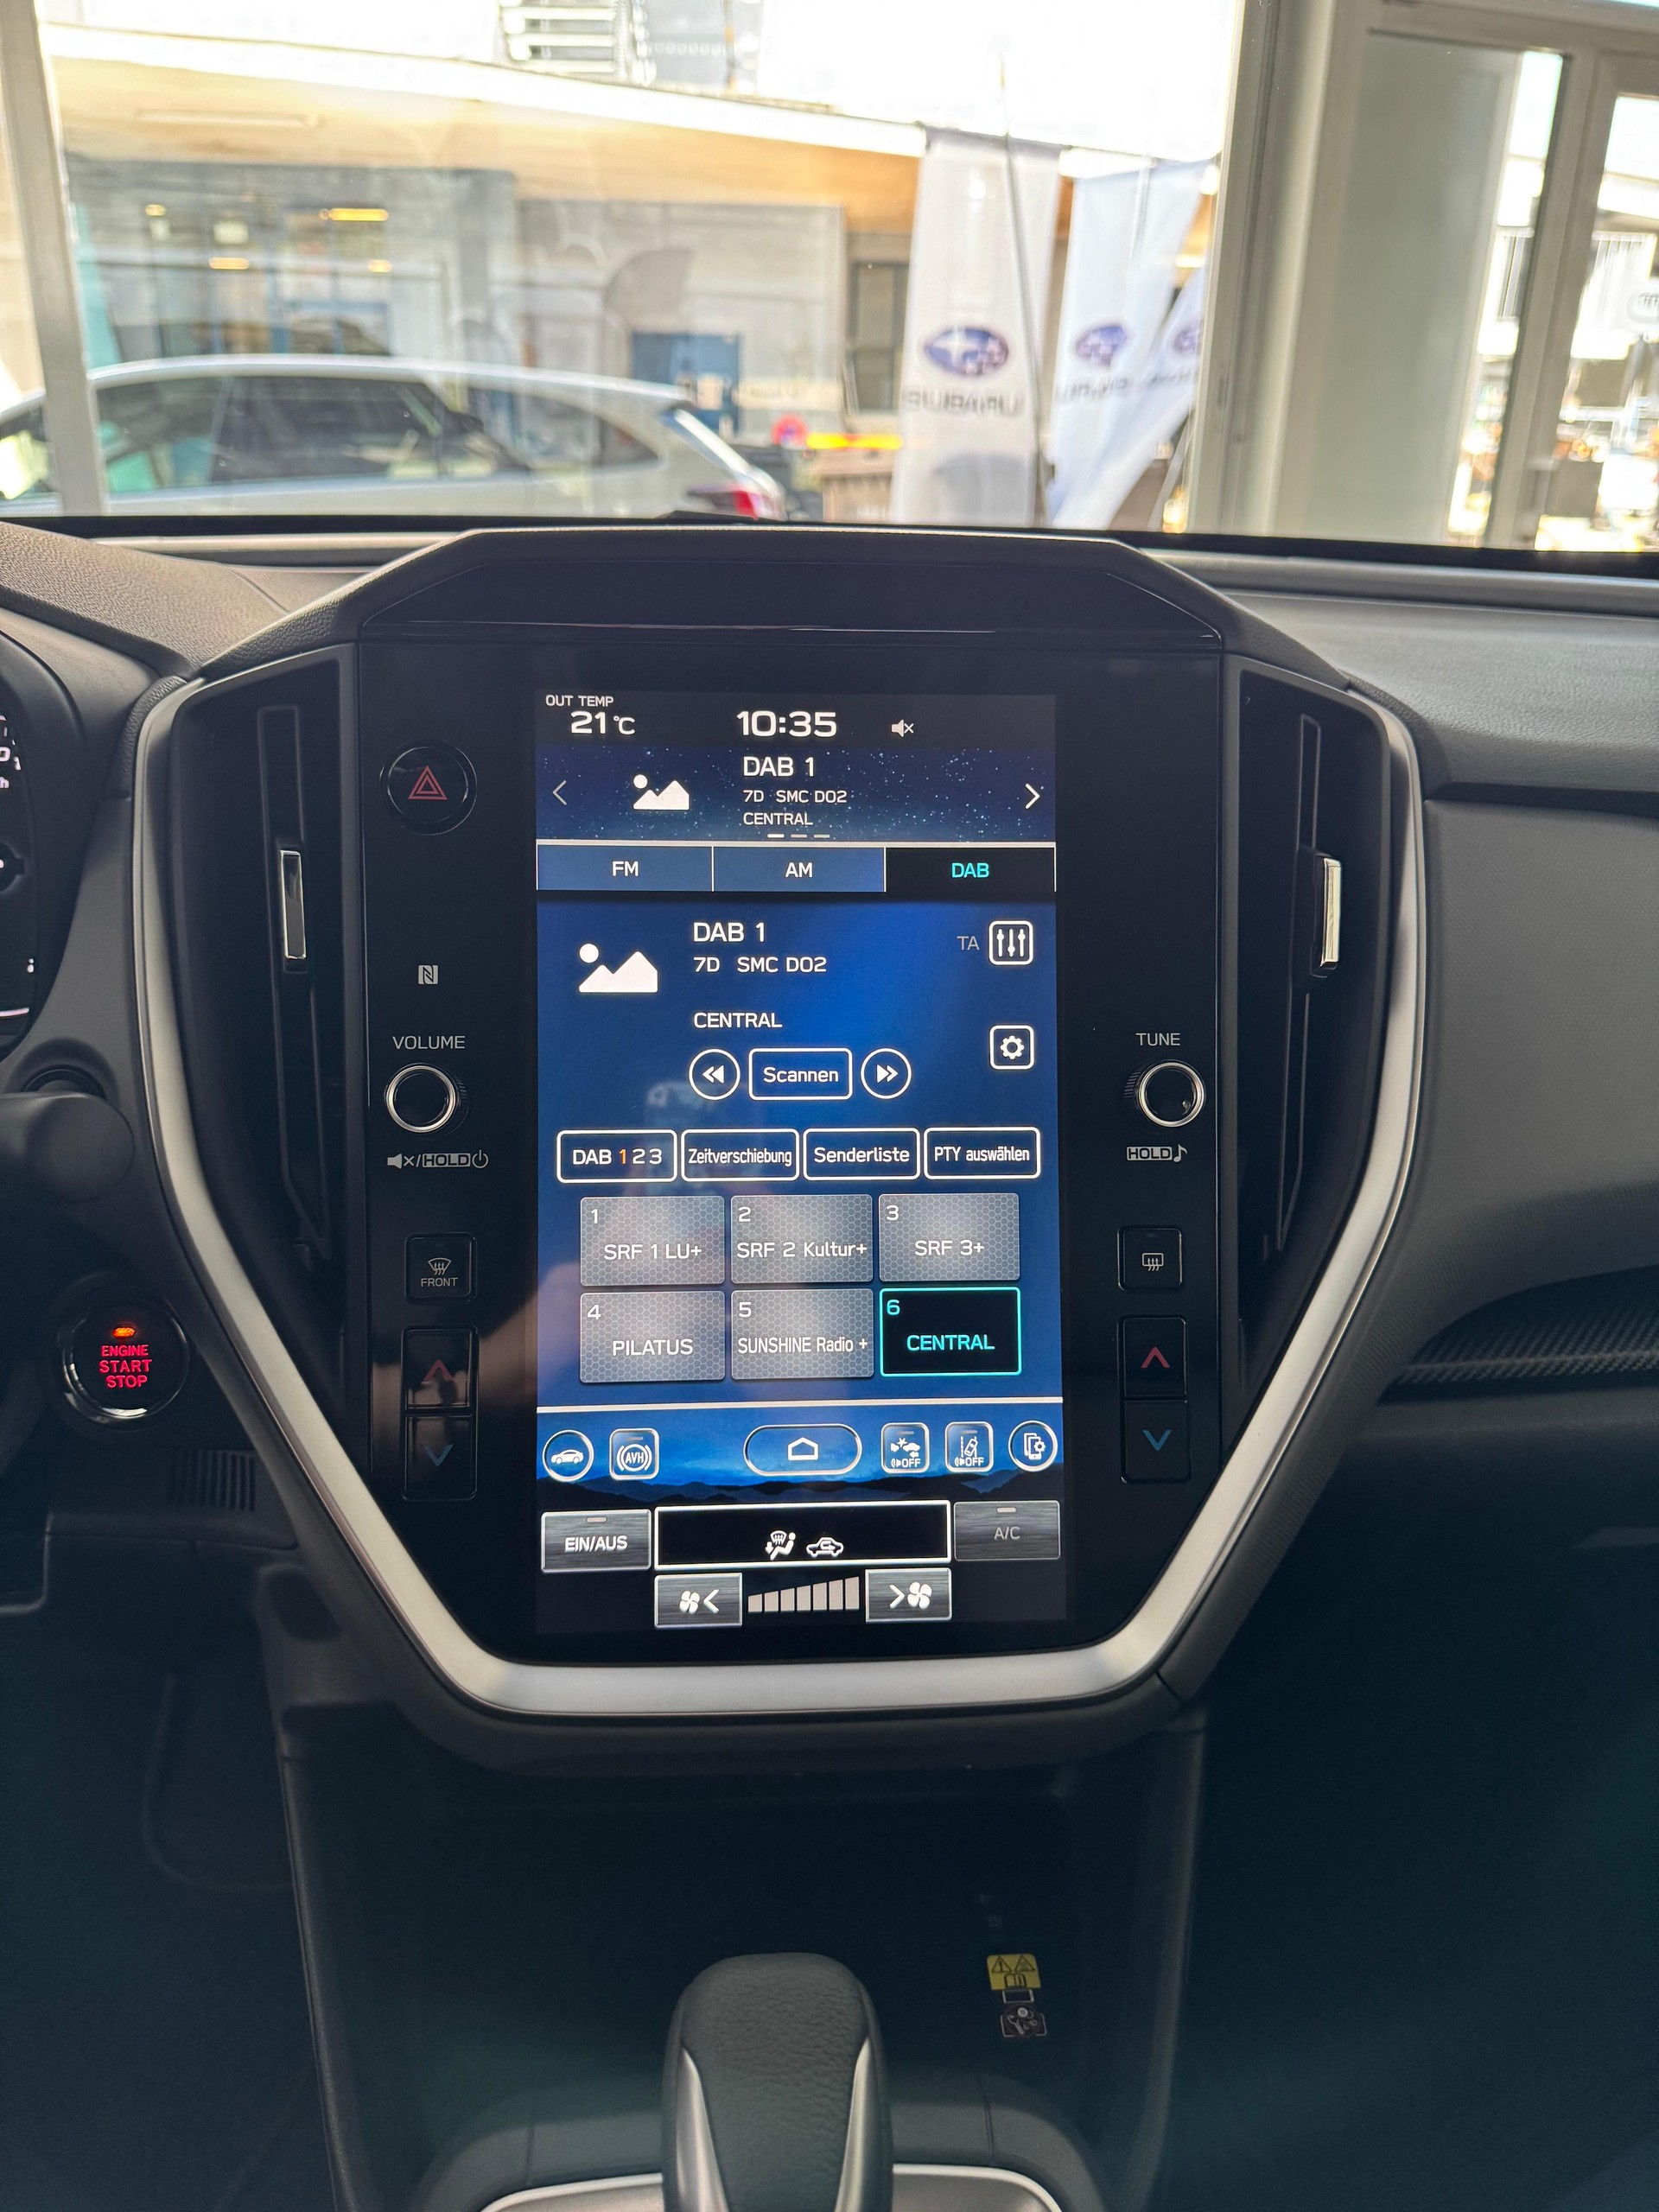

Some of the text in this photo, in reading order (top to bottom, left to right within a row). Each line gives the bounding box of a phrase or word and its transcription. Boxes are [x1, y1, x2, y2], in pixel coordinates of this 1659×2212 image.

[545, 694, 614, 707] OUT TEMP
[570, 710, 606, 734] 21
[736, 710, 837, 737] 10:35
[743, 756, 814, 777] DAB 1
[743, 790, 765, 803] 7D
[776, 790, 810, 804] SMC
[743, 811, 814, 825] CENTRAL
[612, 861, 639, 877] FM
[785, 861, 813, 878] AM
[951, 862, 989, 878] DAB
[693, 922, 765, 943] DAB 1
[957, 935, 980, 950] TA
[693, 957, 721, 972] 7D
[737, 956, 779, 973] SMC
[693, 1012, 783, 1028] CENTRAL
[392, 1035, 466, 1050] VOLUME
[1135, 1033, 1181, 1046] TUNE
[763, 1066, 839, 1083] Scannen
[572, 1148, 612, 1165] DAB
[688, 1147, 792, 1167] Zeitverschiebung
[814, 1147, 910, 1163] Senderliste
[934, 1146, 1030, 1162] PTY auswählen
[590, 1208, 598, 1224] 1
[738, 1206, 752, 1223] 2
[886, 1205, 899, 1221] 3
[603, 1243, 644, 1261] SRF
[650, 1243, 658, 1260] 1
[736, 1241, 868, 1259] SRF 2 Kultur+
[914, 1239, 985, 1256] SRF 3+
[421, 1277, 459, 1287] FRONT
[587, 1304, 601, 1320] 4
[738, 1301, 752, 1318] 5
[887, 1299, 900, 1316] 6
[101, 1344, 149, 1357] ENGINE
[613, 1338, 694, 1357] PILATUS
[738, 1336, 812, 1354] SUNSHINE
[816, 1336, 854, 1353] Radio
[906, 1334, 995, 1351] CENTRAL
[99, 1359, 153, 1374] START
[105, 1375, 148, 1389] STOP
[624, 1451, 645, 1464] AVH
[901, 1458, 921, 1468] OFF
[964, 1455, 985, 1467] OFF
[994, 1525, 1020, 1541] A/C
[564, 1535, 628, 1552] EIN/AUS
